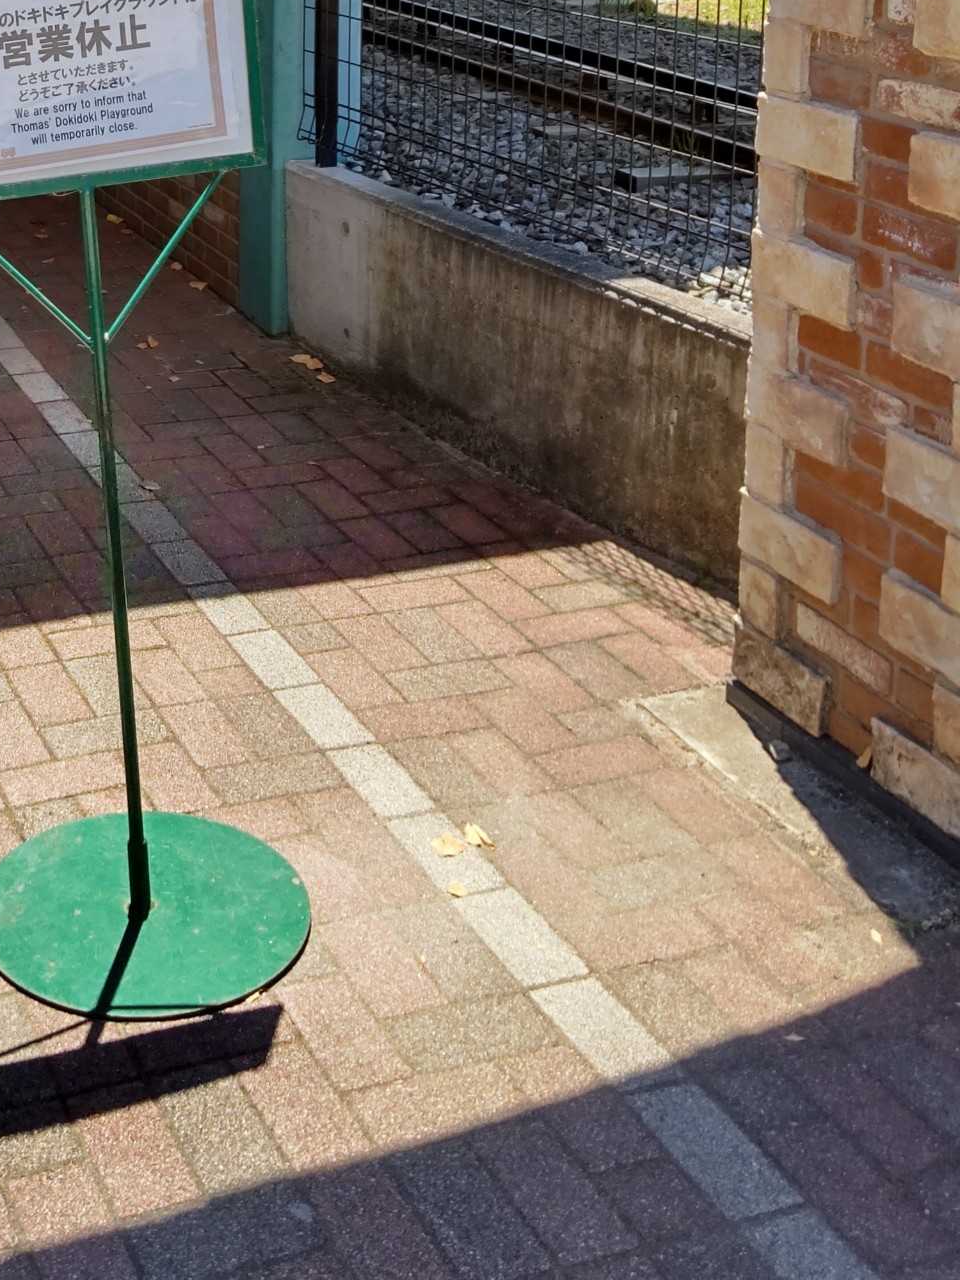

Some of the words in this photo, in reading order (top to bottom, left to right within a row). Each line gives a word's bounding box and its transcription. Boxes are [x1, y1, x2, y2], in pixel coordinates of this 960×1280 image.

[14, 108, 29, 119] We
[33, 106, 49, 117] are
[53, 101, 77, 114] sorry
[81, 98, 90, 109] to
[94, 93, 124, 107] inform
[128, 90, 147, 102] that
[55, 111, 97, 128] Dokidoki
[100, 103, 154, 121] Playground
[31, 134, 48, 145] will
[50, 125, 105, 144] temporarily
